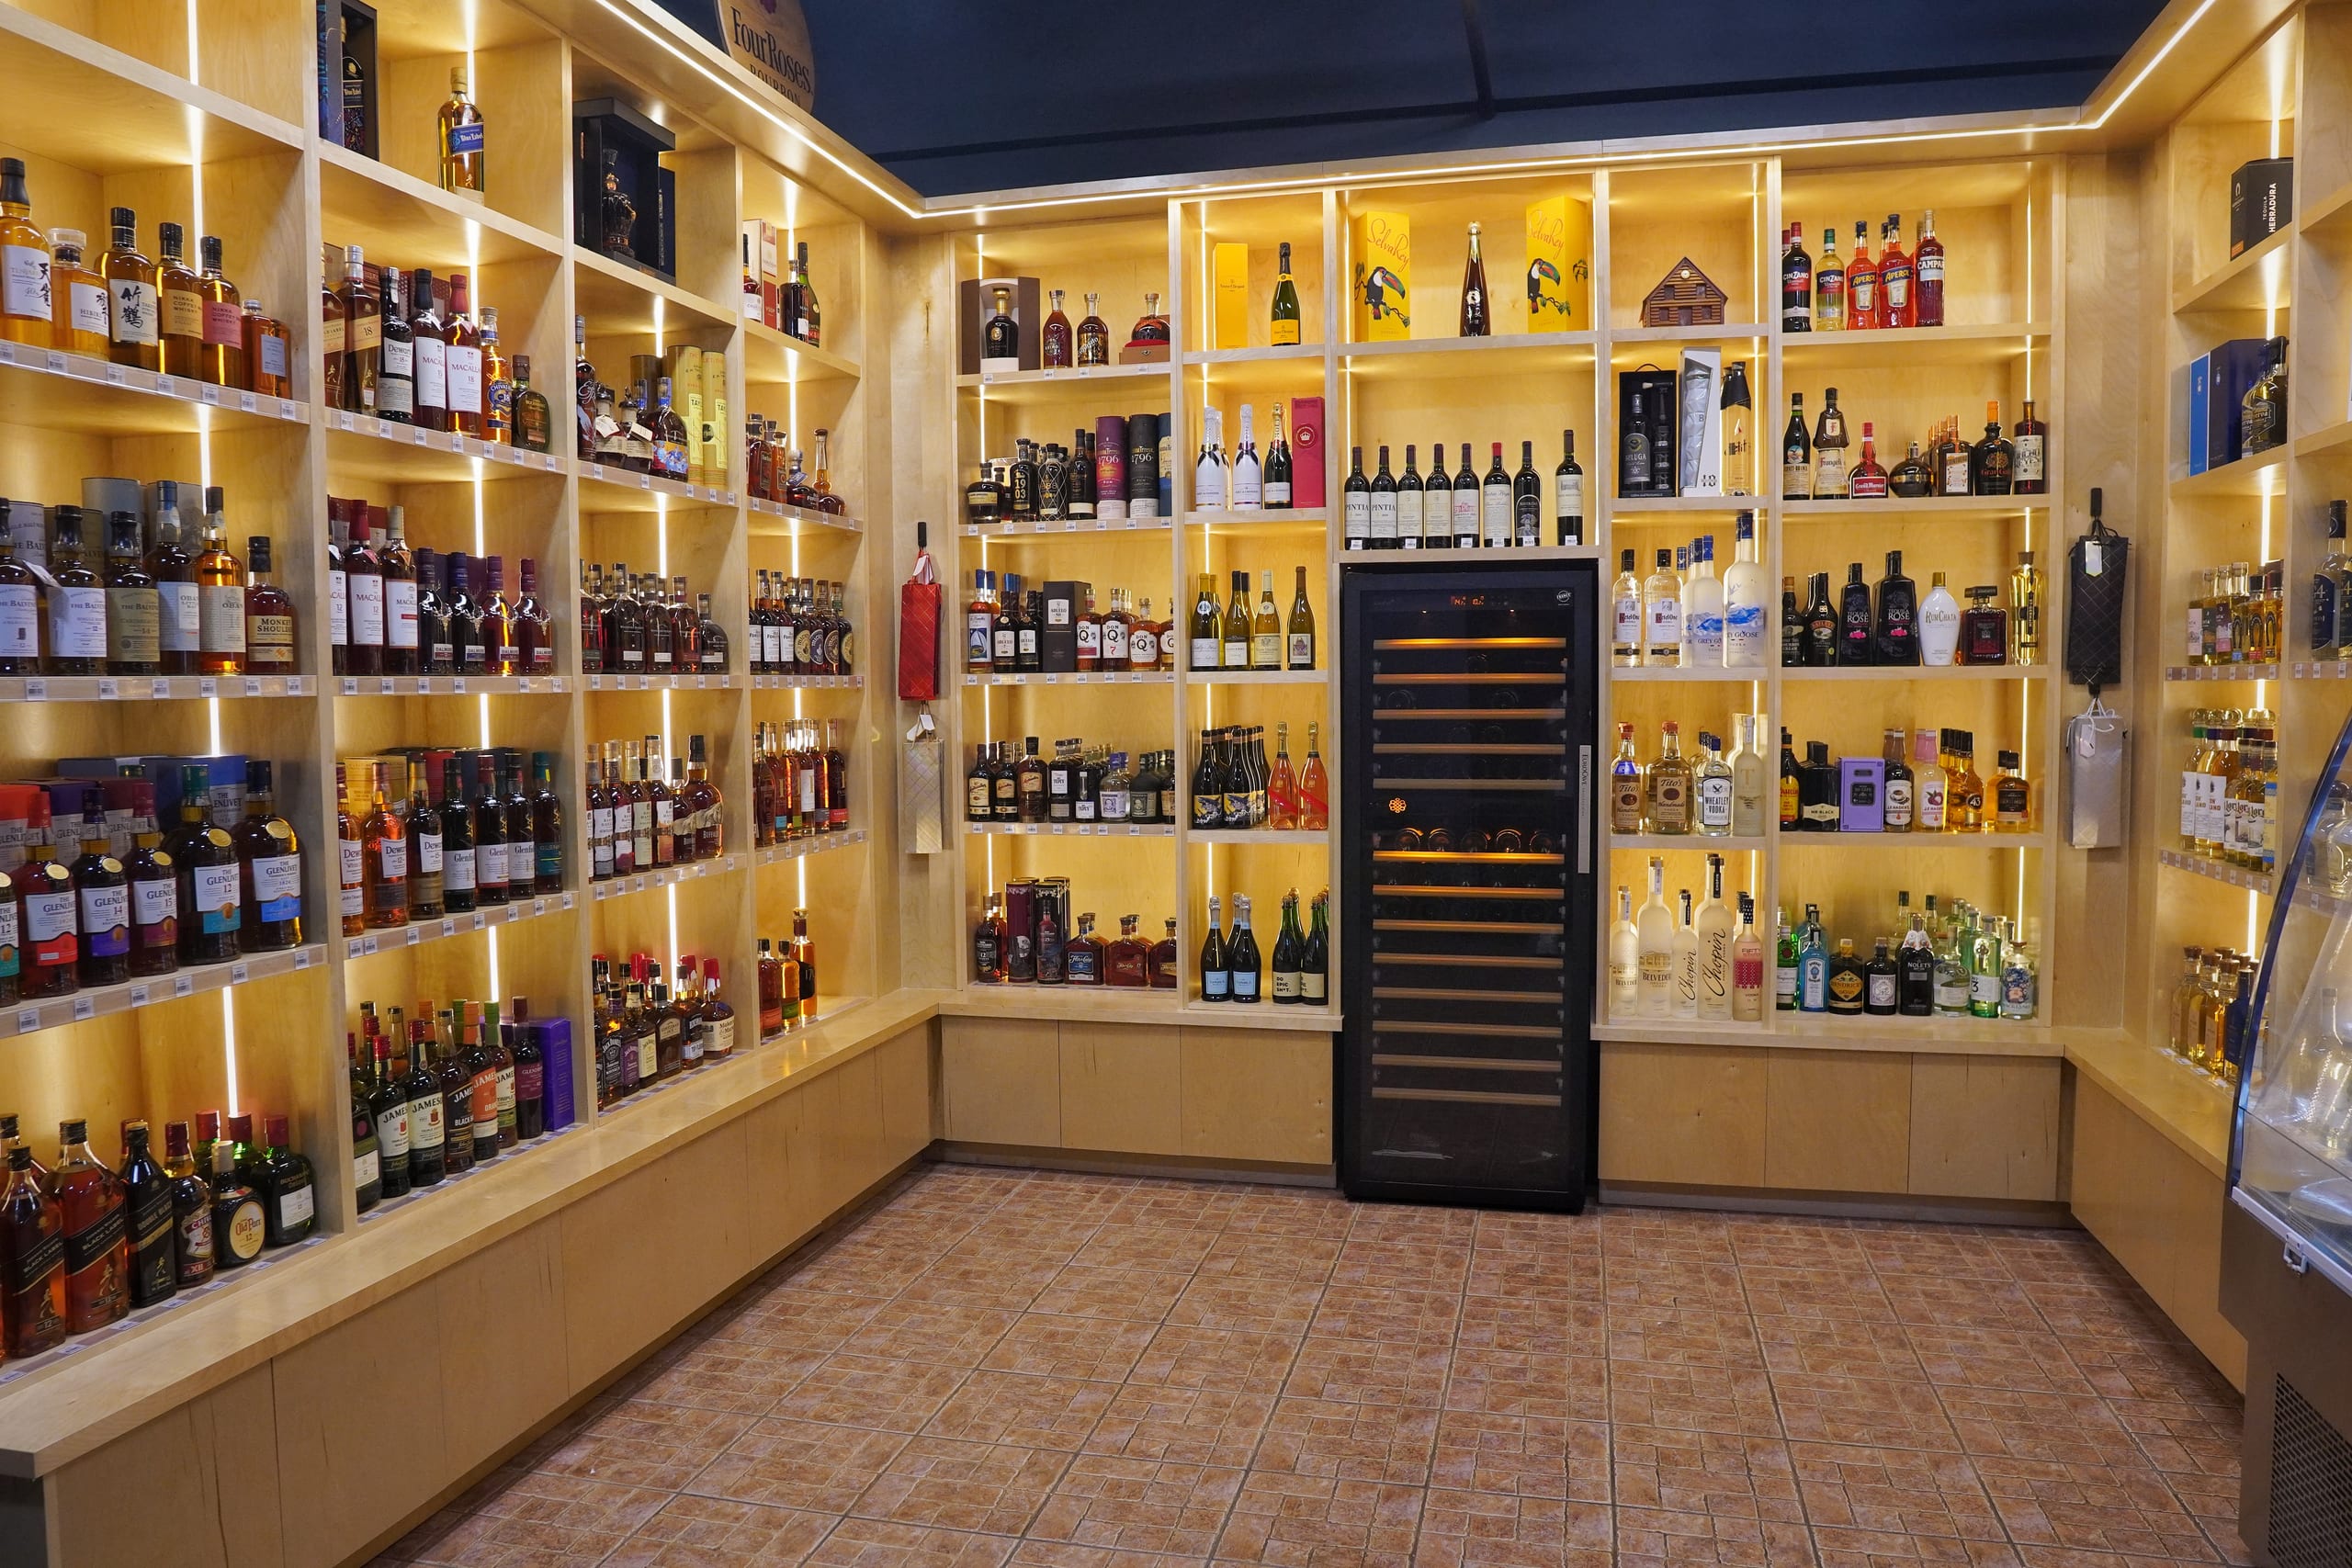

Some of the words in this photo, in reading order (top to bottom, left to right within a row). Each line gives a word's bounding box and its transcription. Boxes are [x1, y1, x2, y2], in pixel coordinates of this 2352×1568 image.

[730, 6, 768, 63] Four
[764, 30, 813, 94] Roses
[2268, 183, 2277, 233] HERRADURA
[1783, 270, 1809, 279] CINZANO
[1819, 274, 1844, 283] CINZANO
[1885, 268, 1909, 280] APEROL
[1853, 275, 1876, 285] APEROL
[364, 327, 373, 336] 18
[1098, 454, 1119, 466] 1796
[1131, 453, 1152, 464] 1796
[1014, 479, 1025, 490] 19
[1014, 489, 1026, 499] 03
[336, 604, 343, 612] 12
[1847, 615, 1869, 624] ROSE
[1888, 613, 1909, 621] ROSE
[1079, 629, 1089, 643] Q
[1107, 629, 1118, 643] Q
[1136, 638, 1148, 650] Q
[1110, 647, 1116, 655] 7
[1660, 778, 1683, 787] Tito's
[1705, 796, 1729, 805] WHEATLEY
[1971, 796, 1981, 807] 43
[1708, 805, 1725, 814] VODKA
[266, 867, 297, 875] GLENLIVET
[223, 884, 232, 893] 12
[164, 898, 173, 907] 15
[113, 907, 123, 915] 14
[1, 924, 12, 934] 12
[1702, 929, 1726, 997] Chopin
[1678, 949, 1697, 1001] Chopin
[1971, 980, 1979, 992] 3
[235, 1220, 246, 1235] Old
[248, 1217, 261, 1231] Parr
[83, 1234, 104, 1249] BLACK
[103, 1218, 124, 1239] LABEL
[191, 1263, 203, 1273] XII
